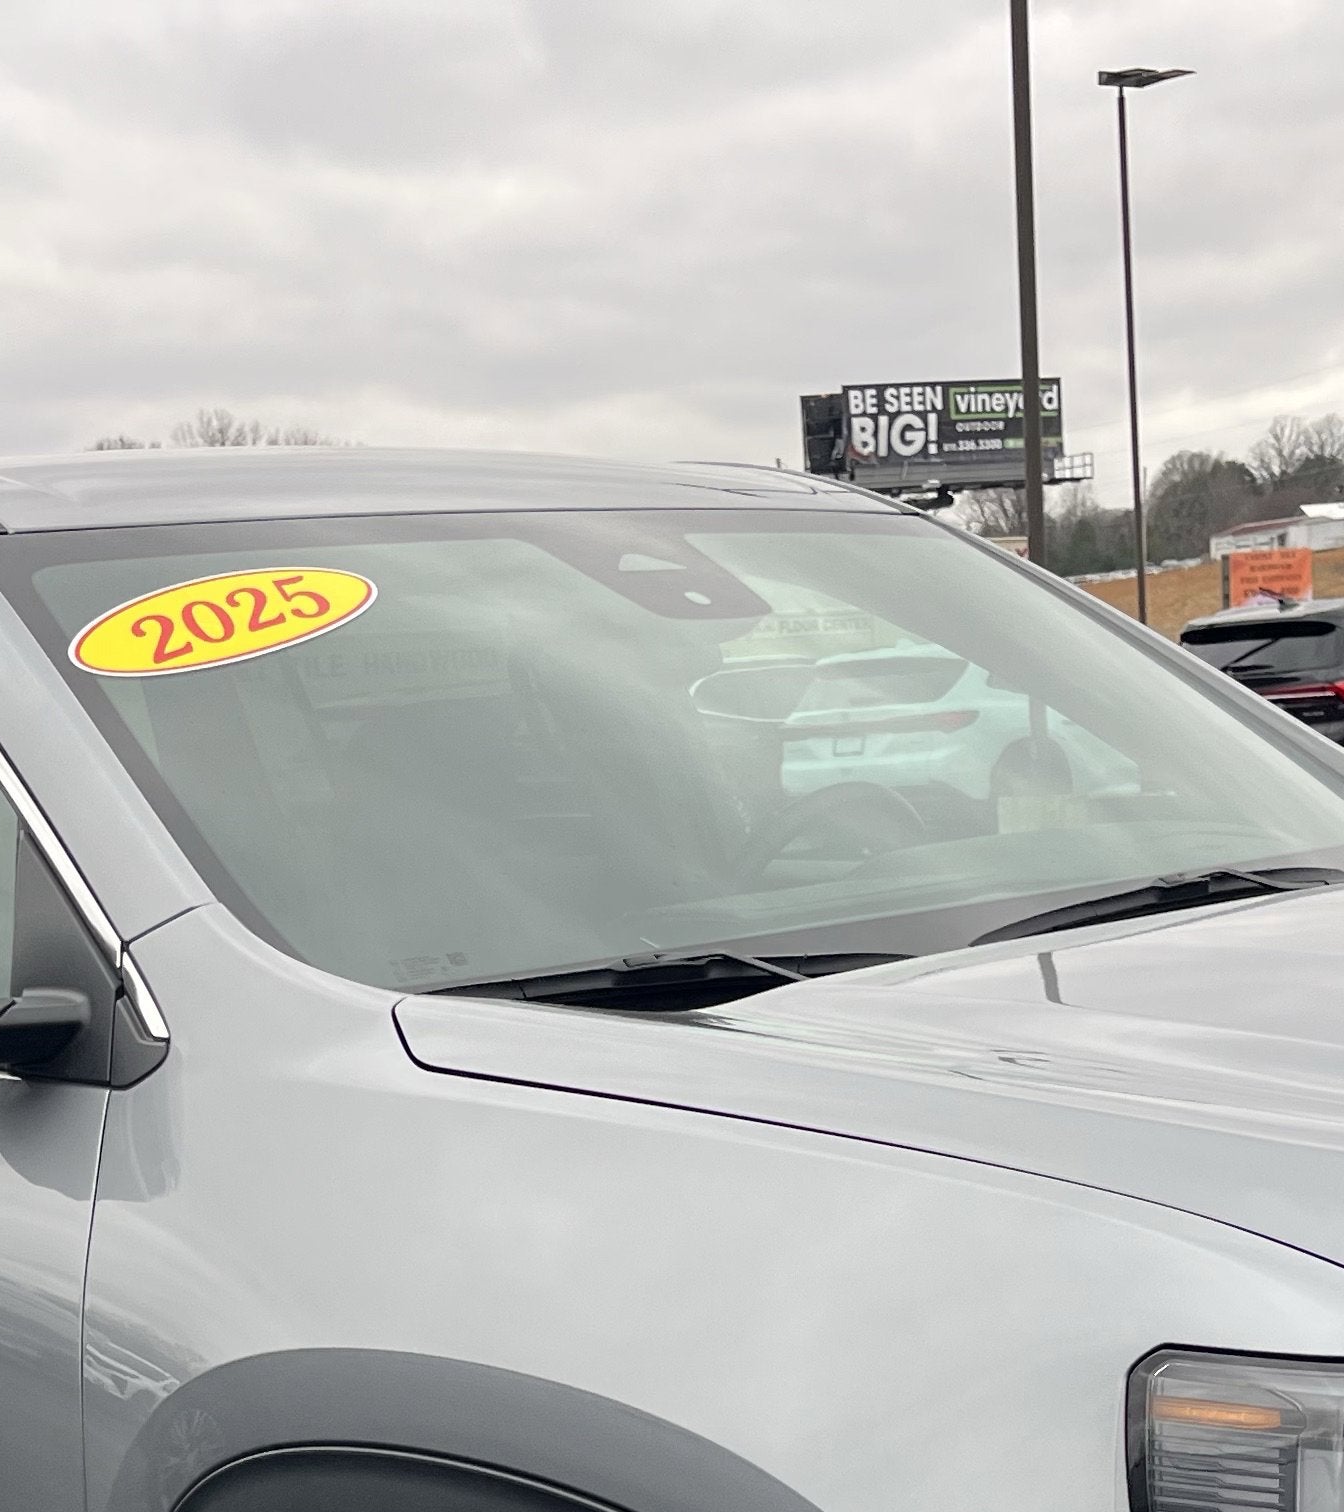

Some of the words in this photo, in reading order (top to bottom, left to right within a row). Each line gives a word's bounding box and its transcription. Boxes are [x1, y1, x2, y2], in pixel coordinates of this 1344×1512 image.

[848, 389, 879, 415] BE
[884, 386, 943, 413] SEEN
[955, 384, 1059, 418] vineyd
[850, 412, 939, 458] BIG!
[131, 575, 331, 665] 2025
